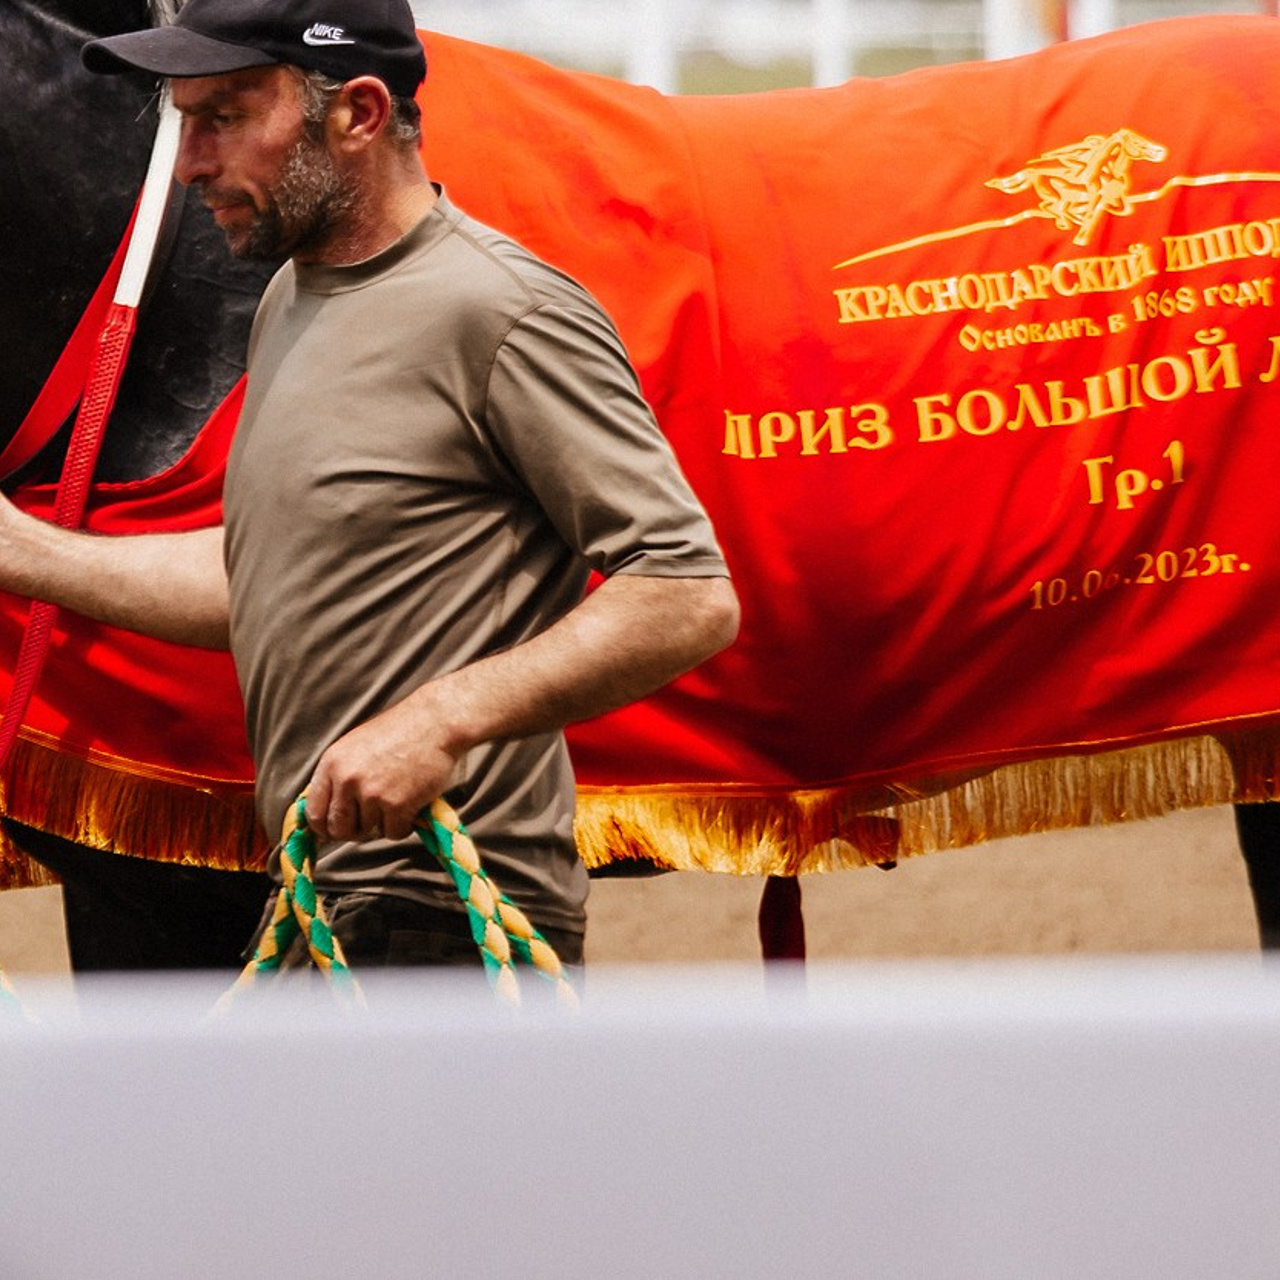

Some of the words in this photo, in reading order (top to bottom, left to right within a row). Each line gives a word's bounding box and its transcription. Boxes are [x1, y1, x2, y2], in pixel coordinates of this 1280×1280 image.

[310, 22, 344, 40] NIKE
[833, 243, 1157, 323] КРАСНОДАРСКИЙ
[1107, 313, 1126, 334] в
[1131, 286, 1199, 322] 1868
[1204, 276, 1275, 308] году
[722, 402, 894, 460] ПРИЗ
[913, 326, 1243, 443] БОЛЬШОЙ
[1082, 439, 1186, 510] Гр.1
